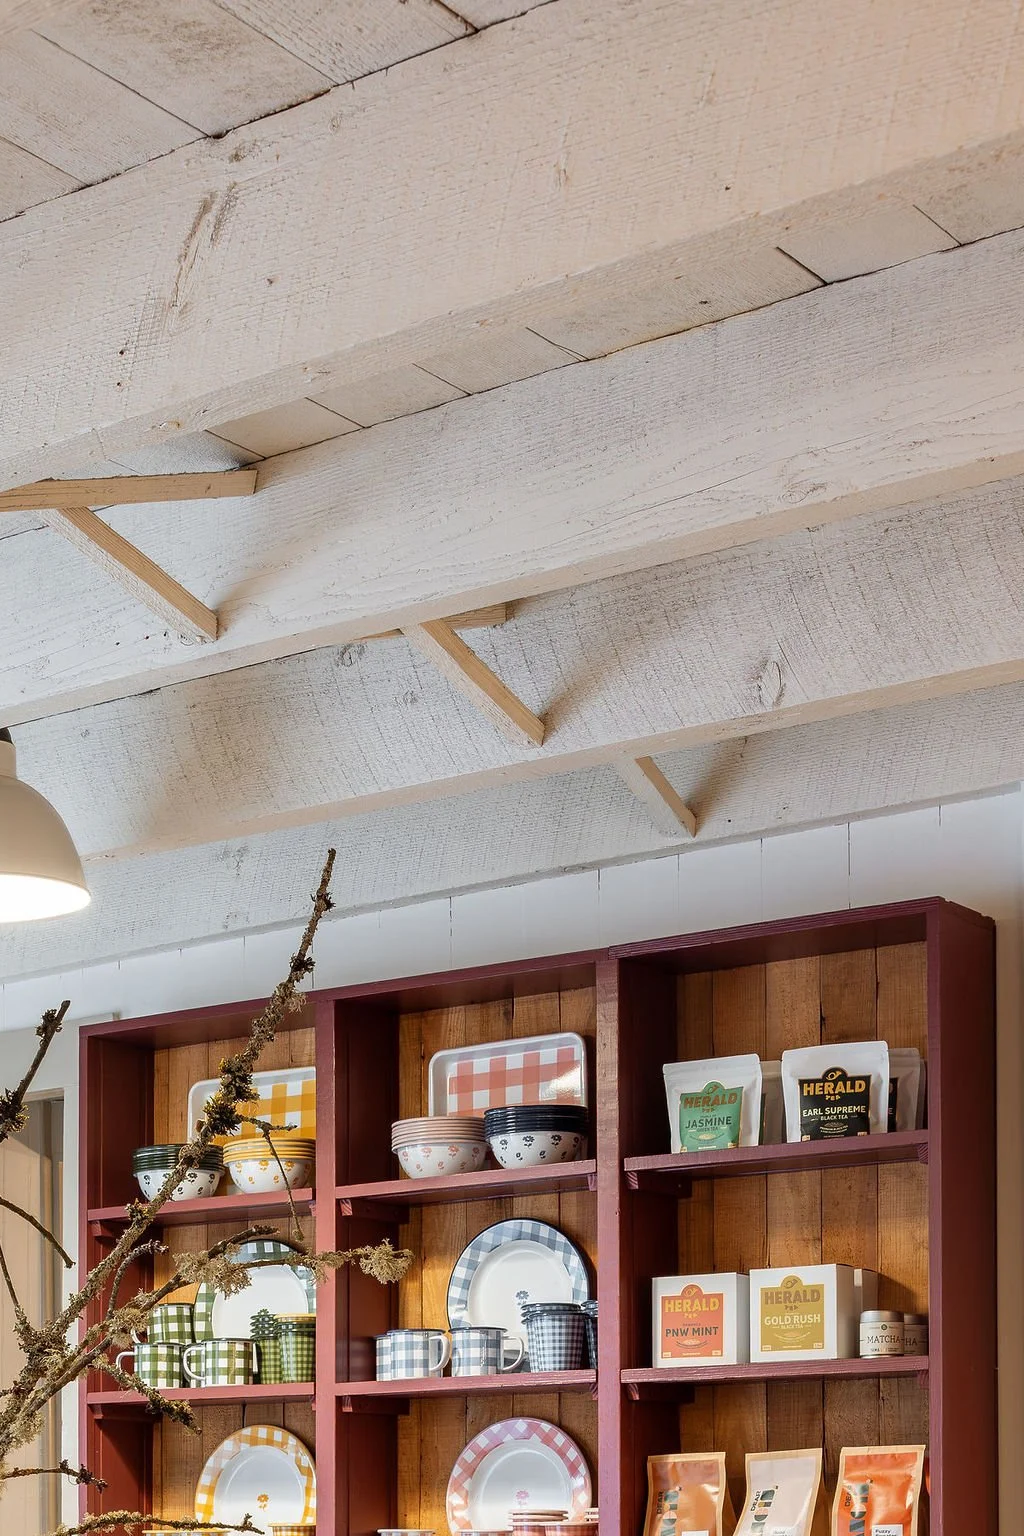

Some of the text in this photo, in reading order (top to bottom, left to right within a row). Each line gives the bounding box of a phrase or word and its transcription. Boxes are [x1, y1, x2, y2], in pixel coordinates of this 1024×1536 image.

[803, 1080, 866, 1096] HERALD
[683, 1092, 738, 1110] HERALD
[802, 1105, 866, 1117] EARL SUPREME
[685, 1116, 732, 1129] JASMINE
[764, 1289, 821, 1305] HERALD
[664, 1298, 719, 1313] HERALD
[764, 1313, 821, 1326] GOLD RUSH
[665, 1326, 719, 1338] PNW MINT
[867, 1334, 901, 1344] MATCHA
[750, 1490, 762, 1512] DEAR
